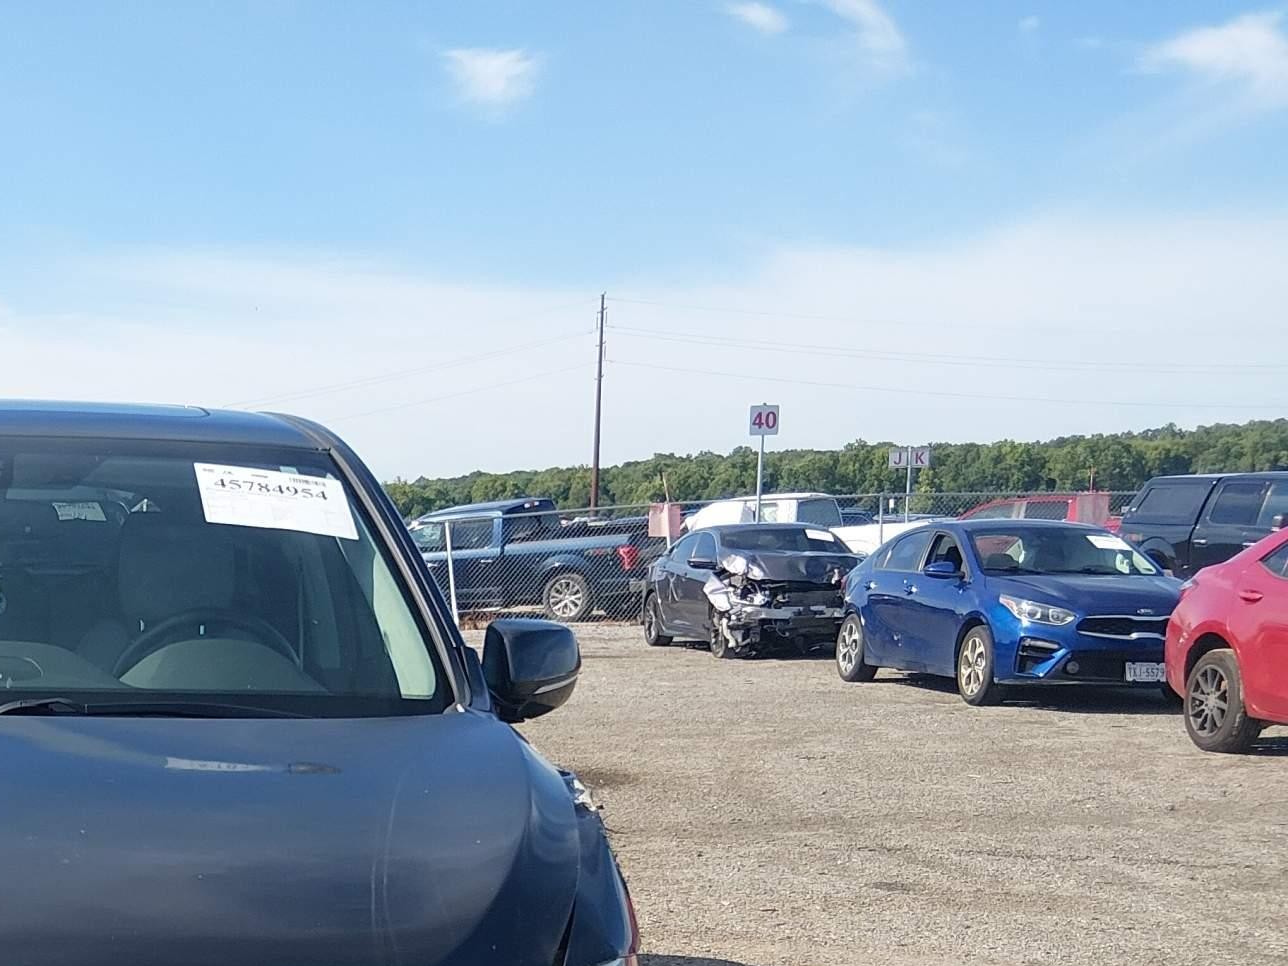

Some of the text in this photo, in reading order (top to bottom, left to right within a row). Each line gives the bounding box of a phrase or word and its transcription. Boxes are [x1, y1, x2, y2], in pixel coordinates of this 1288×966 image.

[751, 411, 777, 430] 40
[893, 451, 902, 465] J
[914, 451, 925, 465] K
[213, 478, 329, 501] 45784954
